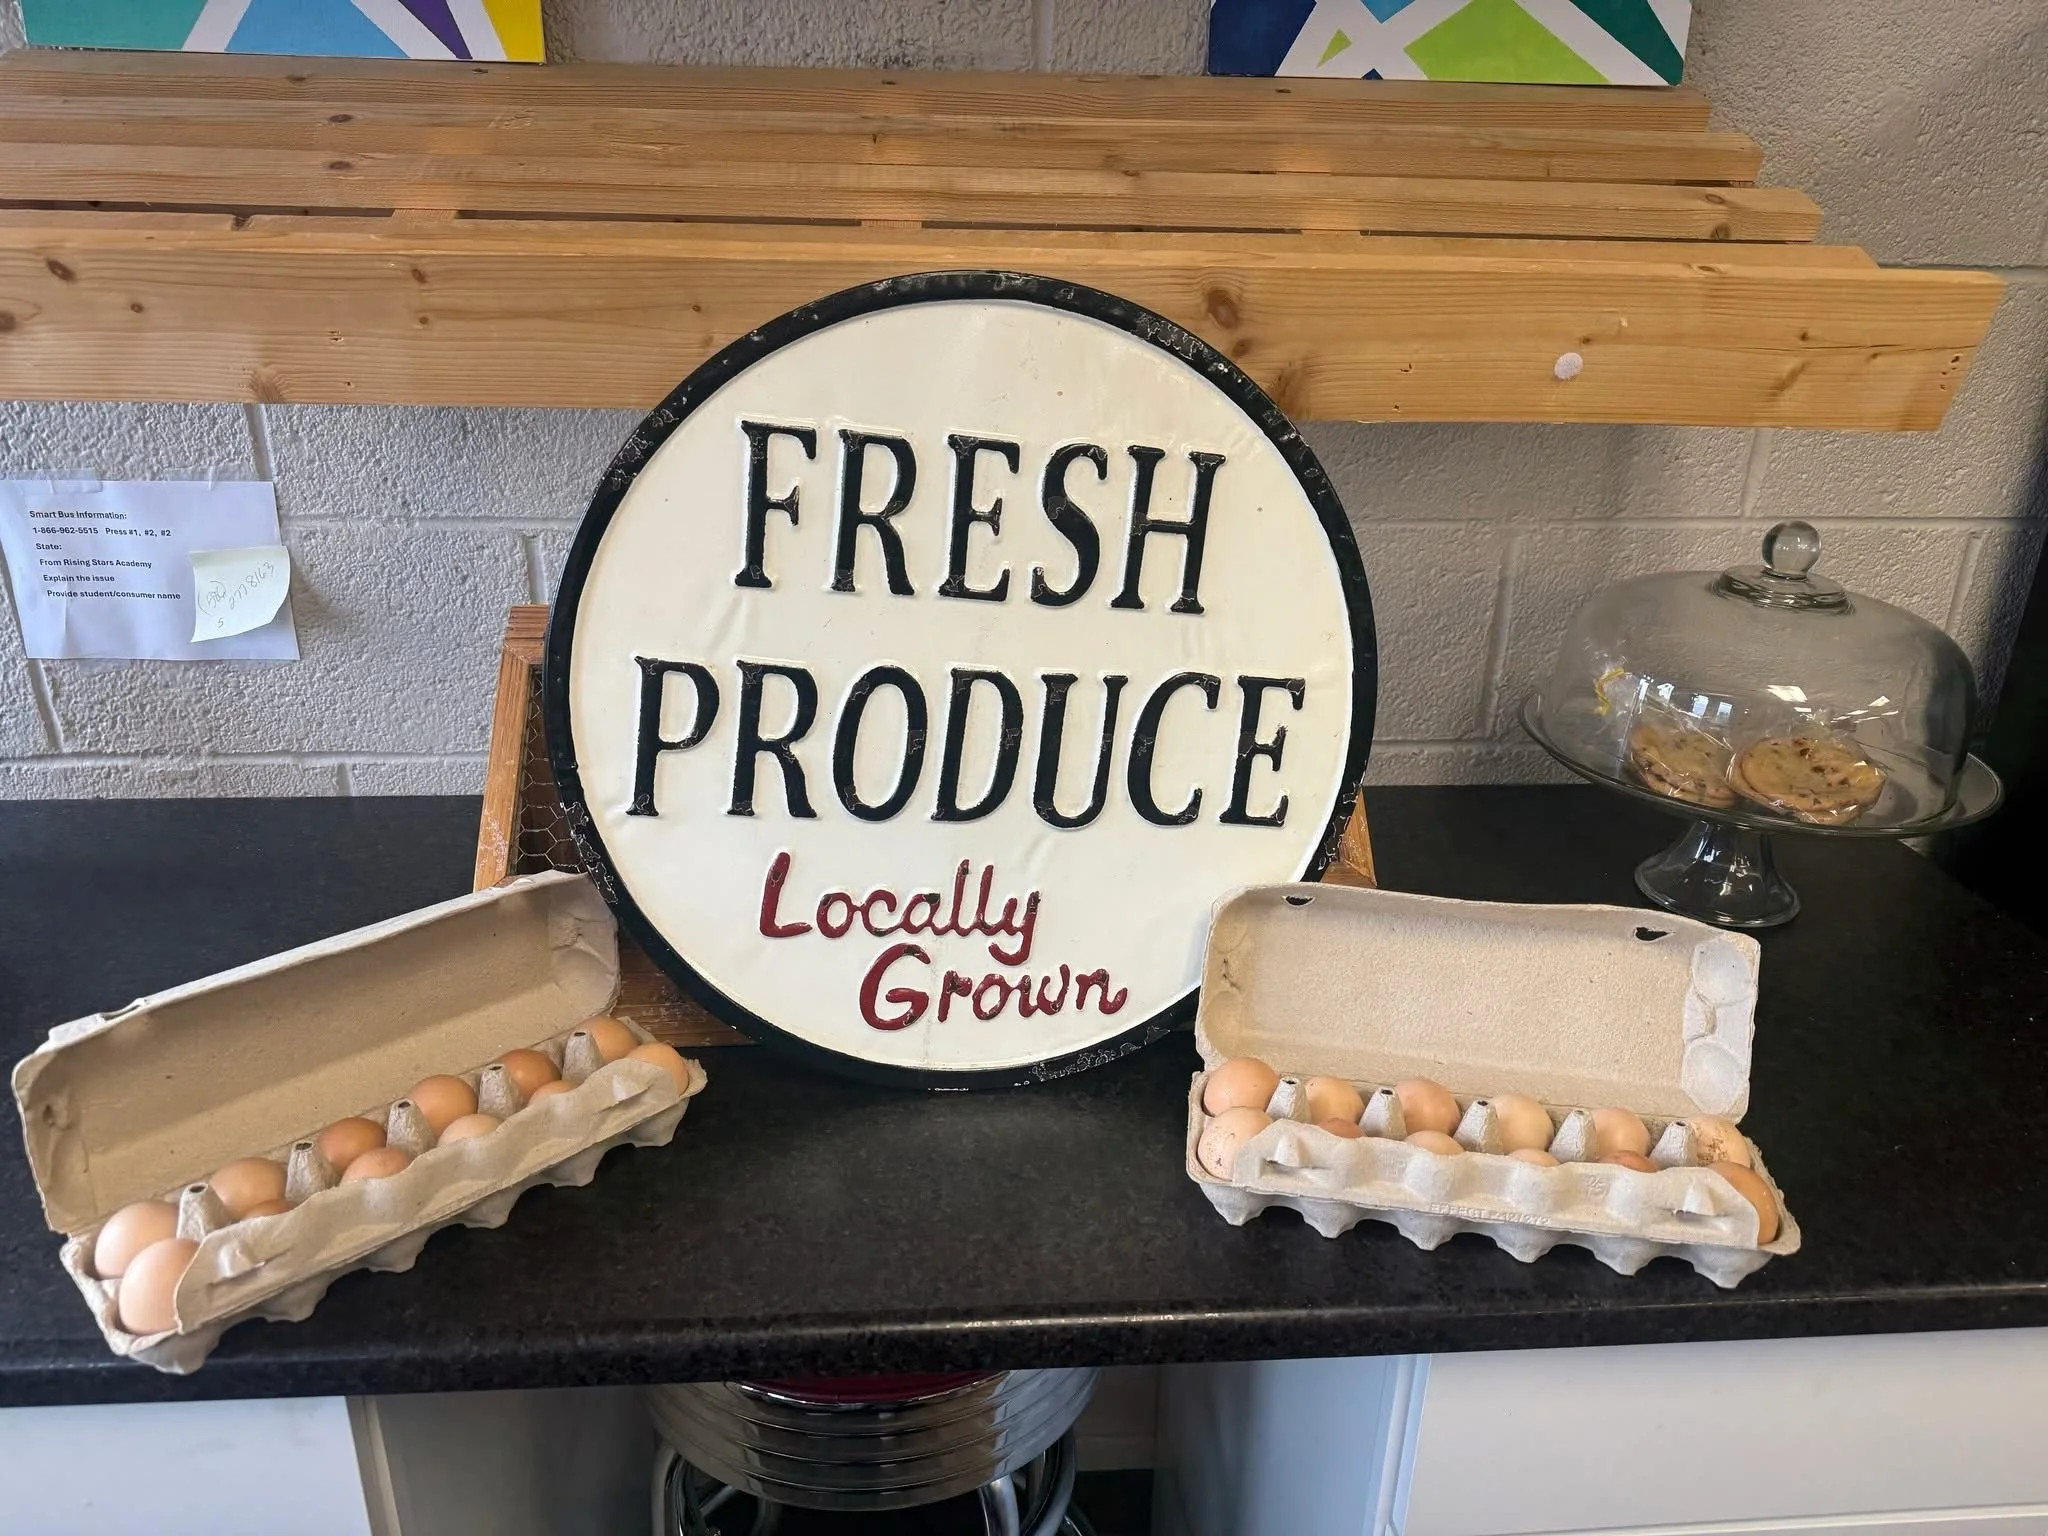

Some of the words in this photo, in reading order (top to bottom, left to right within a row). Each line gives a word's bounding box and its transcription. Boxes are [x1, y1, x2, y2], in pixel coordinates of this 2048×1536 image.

[29, 510, 57, 519] Smart
[57, 510, 75, 519] Bus
[76, 511, 127, 520] Information:
[735, 420, 1226, 615] FRESH
[32, 526, 99, 535] 1-866-962-5515
[105, 527, 128, 536] Press
[128, 529, 142, 537] #1,
[144, 529, 158, 537] #2,
[160, 529, 172, 537] #2
[35, 542, 63, 551] State:
[39, 558, 62, 566] From
[63, 558, 91, 568] Rising
[91, 558, 115, 567] Stars
[115, 560, 152, 569] Academy
[43, 574, 75, 583] Explain
[75, 574, 91, 582] the
[92, 574, 116, 582] issue
[46, 589, 79, 598] Provide
[79, 590, 156, 599] student/consumer
[625, 655, 1306, 829] PRODUCE
[759, 851, 1041, 966] Locally
[859, 943, 1128, 1031] Grown
